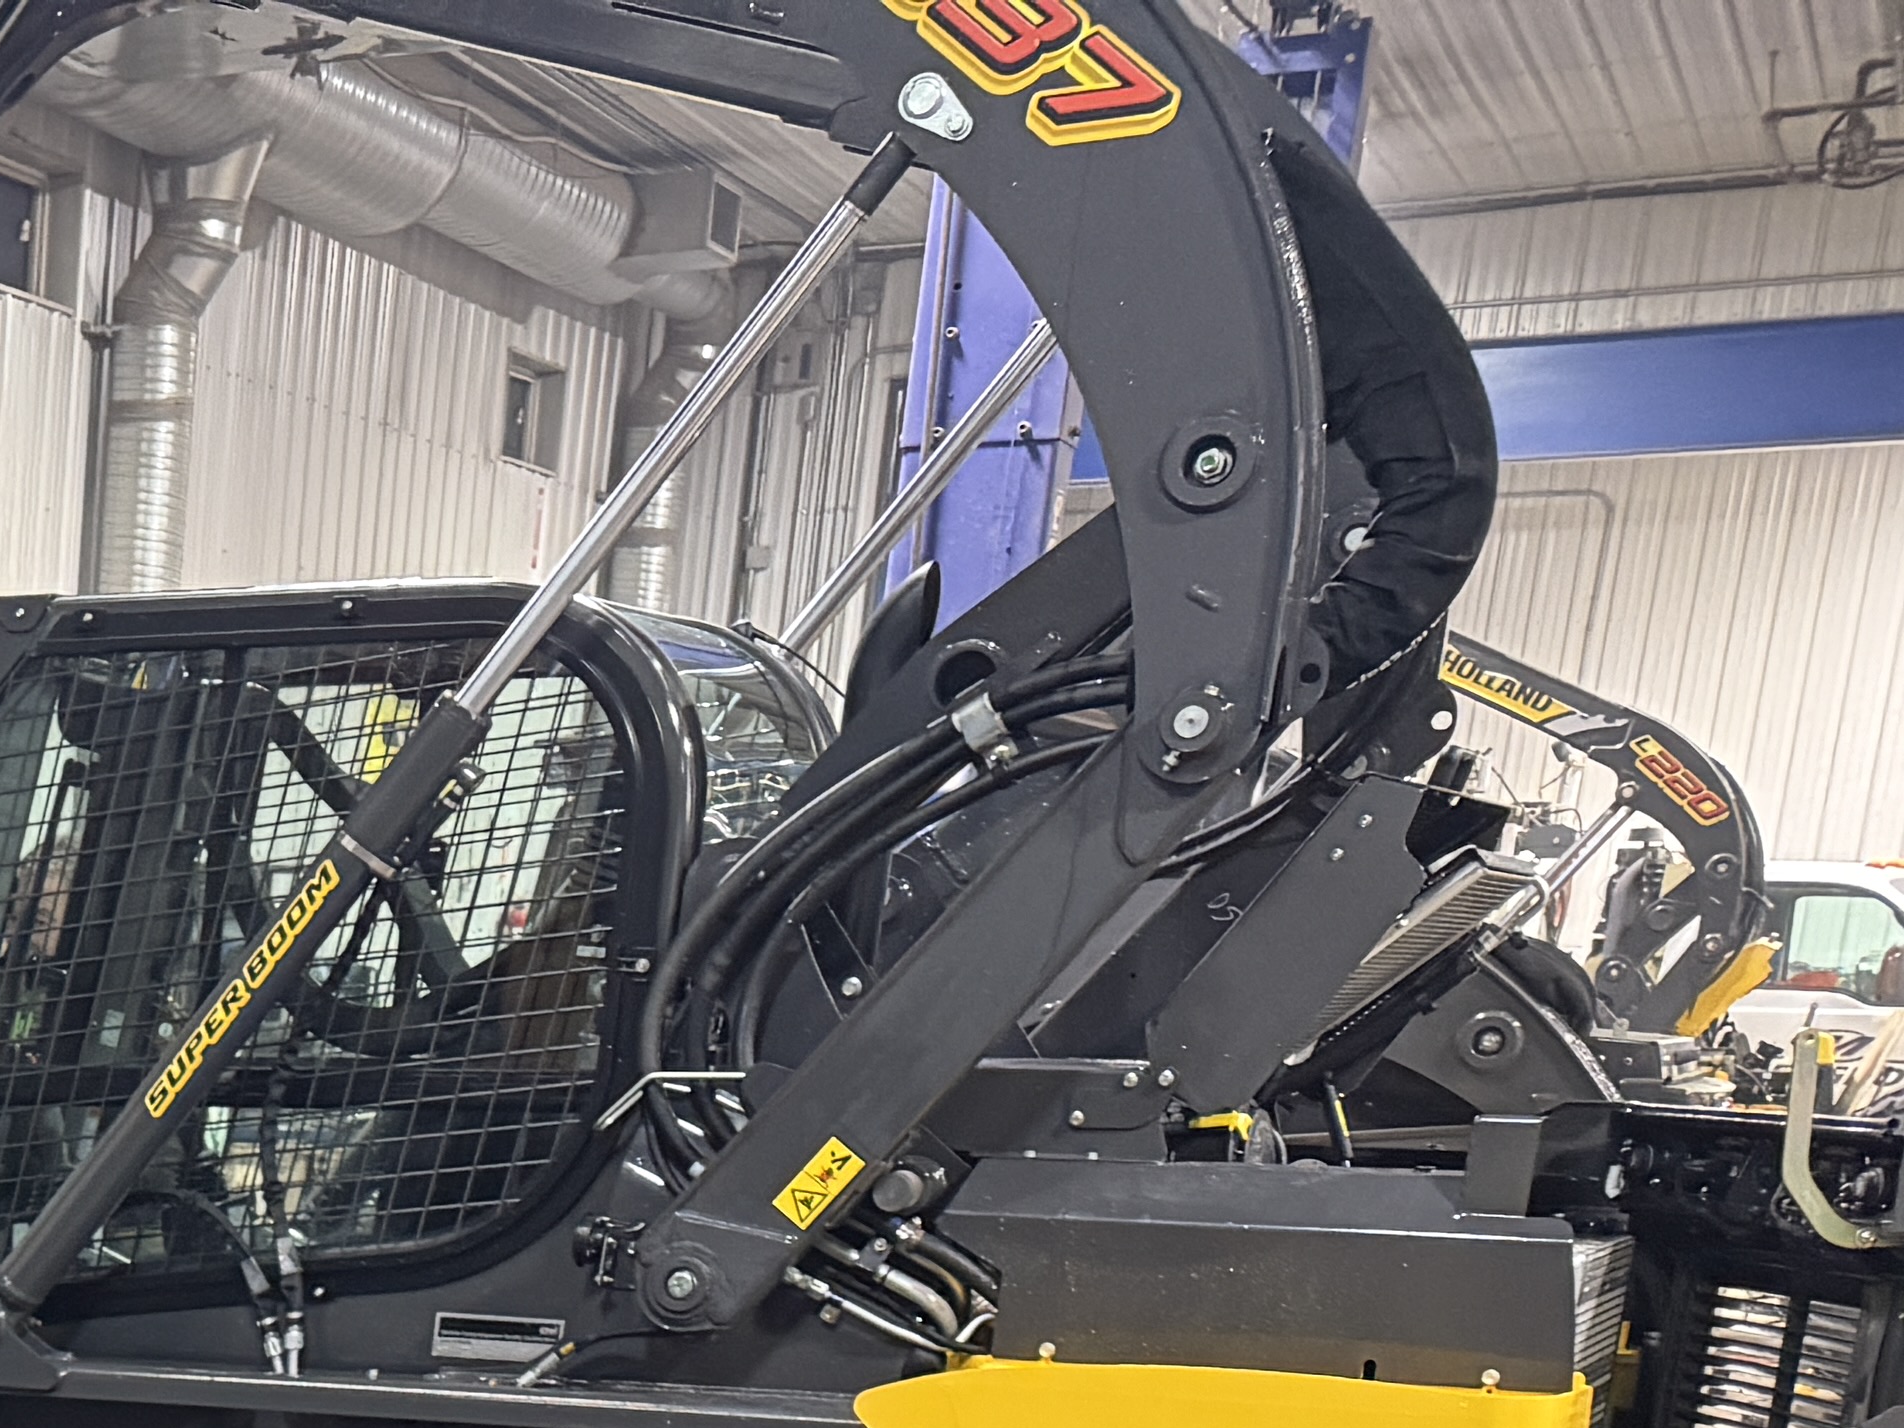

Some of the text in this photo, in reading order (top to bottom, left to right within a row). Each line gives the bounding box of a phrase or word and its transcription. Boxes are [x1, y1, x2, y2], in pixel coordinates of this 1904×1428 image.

[1443, 648, 1553, 713] HOLLAND
[146, 862, 339, 1116] SUPER BOOM
